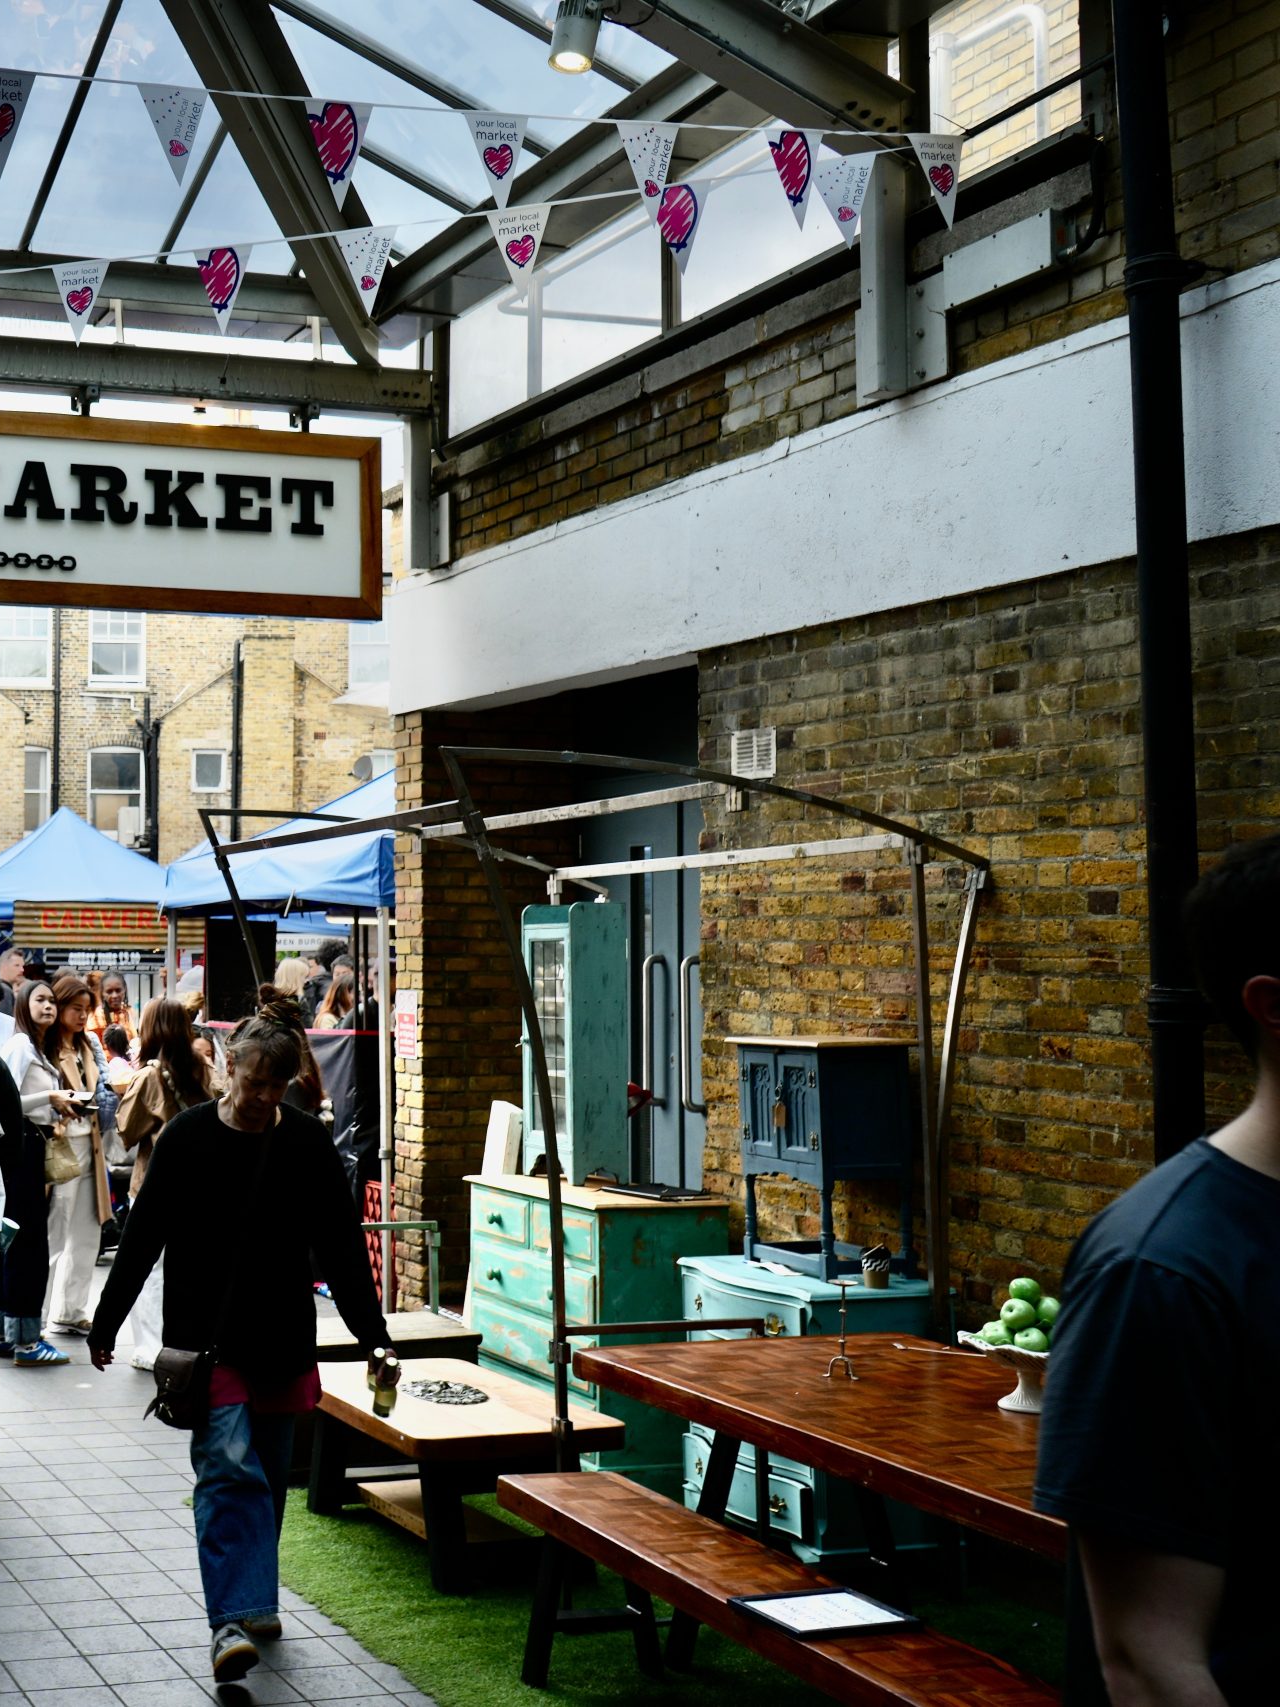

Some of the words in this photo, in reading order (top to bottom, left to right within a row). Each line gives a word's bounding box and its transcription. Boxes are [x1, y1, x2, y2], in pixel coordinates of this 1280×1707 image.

[0, 77, 22, 88] local
[173, 117, 182, 138] your
[180, 99, 189, 118] local
[184, 101, 203, 143] market
[475, 120, 494, 128] your
[496, 121, 517, 129] local
[475, 130, 518, 142] market
[919, 142, 936, 150] your
[647, 157, 656, 177] your
[652, 135, 661, 157] local
[656, 138, 672, 182] market
[920, 150, 956, 162] market
[844, 166, 856, 184] local
[841, 185, 850, 204] your
[852, 166, 869, 206] market
[498, 216, 517, 226] your
[519, 212, 539, 222] local
[498, 222, 541, 236] market
[364, 255, 374, 273] your
[369, 236, 379, 255] local
[374, 238, 390, 276] market
[61, 276, 99, 287] market
